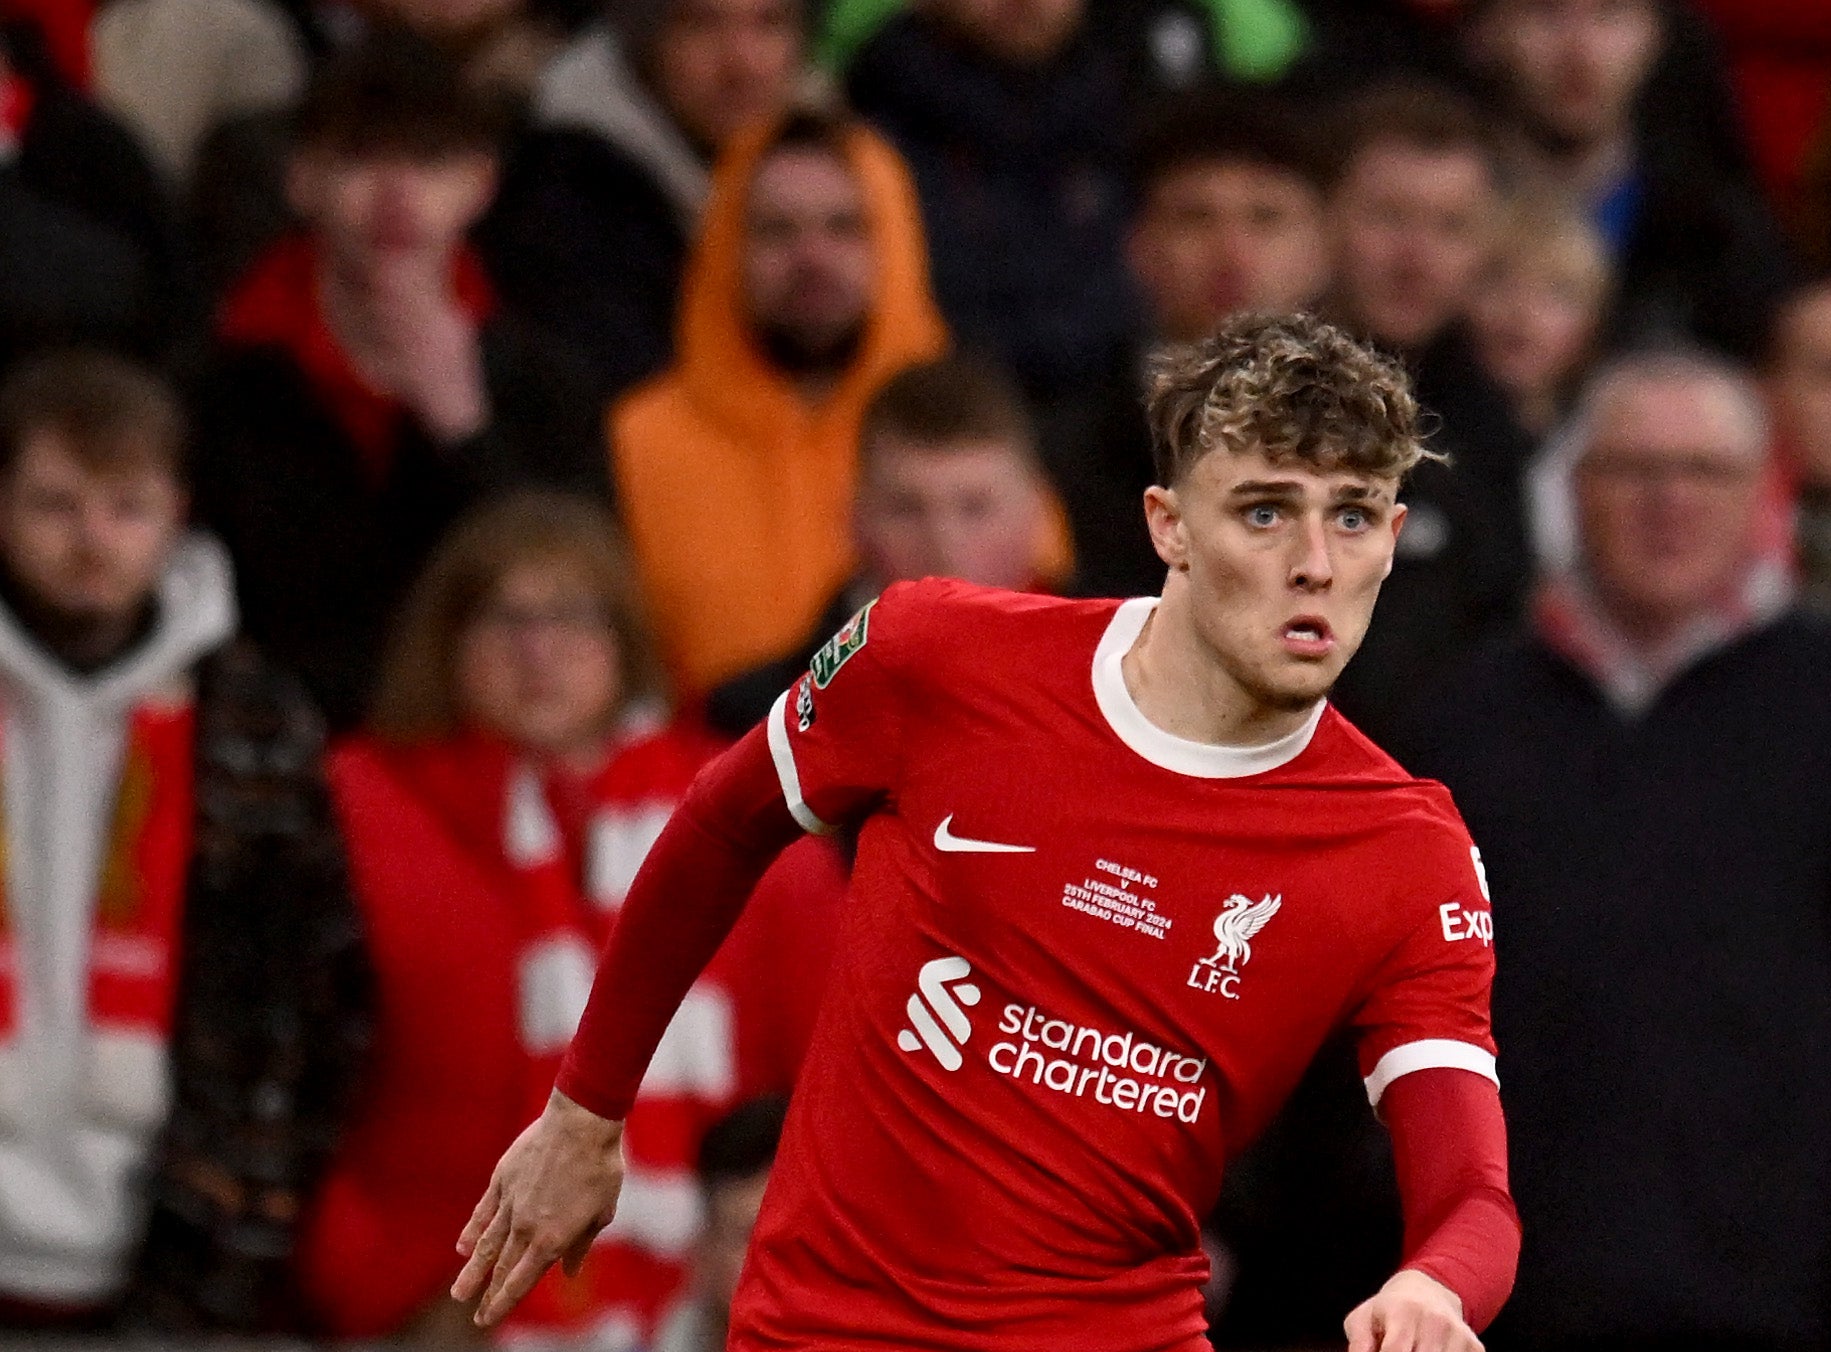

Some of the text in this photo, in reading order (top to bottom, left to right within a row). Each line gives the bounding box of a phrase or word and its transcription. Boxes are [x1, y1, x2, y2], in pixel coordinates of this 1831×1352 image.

[1084, 878, 1156, 911] LIVERPOOL FC
[1095, 858, 1158, 888] CHELSEA FC
[1062, 896, 1165, 939] CARABAO CUP FINAL
[1063, 883, 1172, 929] 25TH FEBRUARY 2024
[999, 1003, 1207, 1083] standard
[988, 1042, 1206, 1123] chartered
